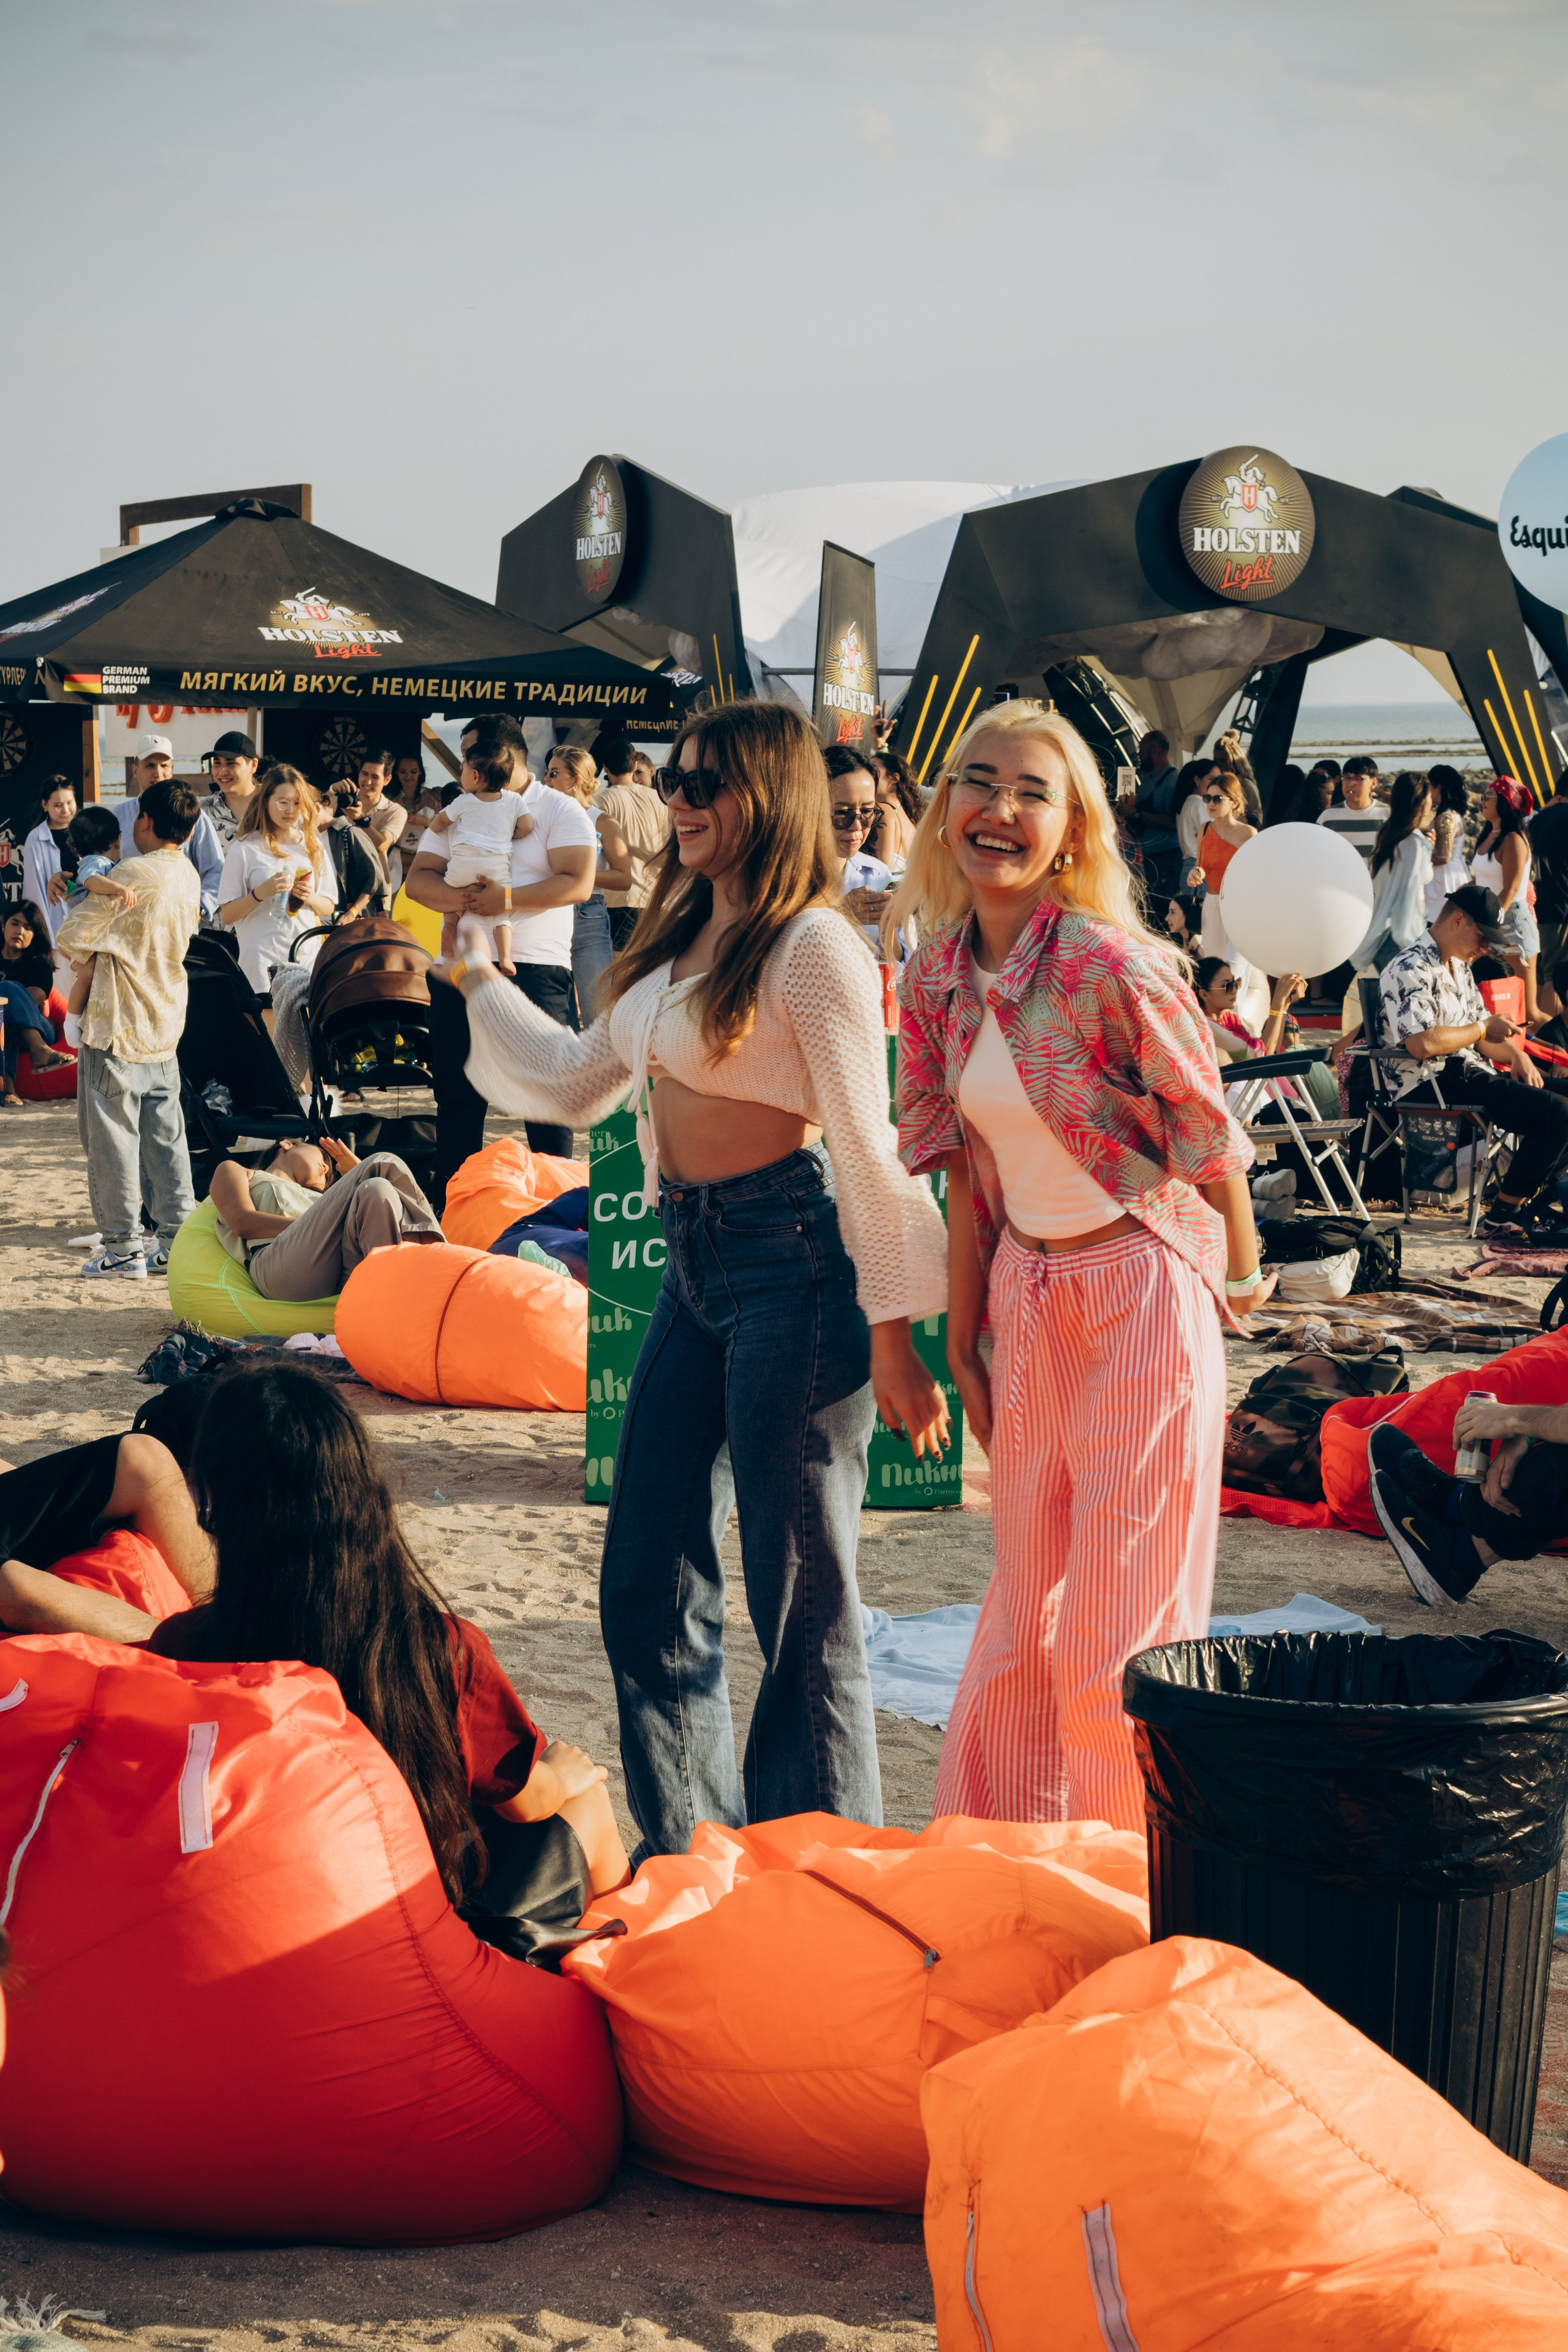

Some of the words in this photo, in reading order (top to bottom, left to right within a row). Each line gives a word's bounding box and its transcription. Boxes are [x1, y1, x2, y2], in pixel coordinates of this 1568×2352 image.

[576, 532, 622, 560] HOLSTEN
[1193, 527, 1301, 554] HOLSTEN
[587, 557, 611, 594] Light
[1220, 555, 1274, 590] Light
[258, 627, 403, 643] HOLSTEN
[313, 643, 382, 658] Light
[102, 666, 148, 676] GERMAN
[102, 676, 150, 685] PREMIUM
[102, 685, 138, 694] BRAND
[180, 669, 286, 692] МЯГКИЙ
[293, 674, 364, 697] ВКУС,
[371, 677, 506, 702] НЕМЕЦКИЕ
[514, 682, 647, 707] ТРАДИЦИИ
[823, 683, 875, 716] HOLSTEN
[836, 714, 864, 745] Light
[590, 1409, 600, 1419] by
